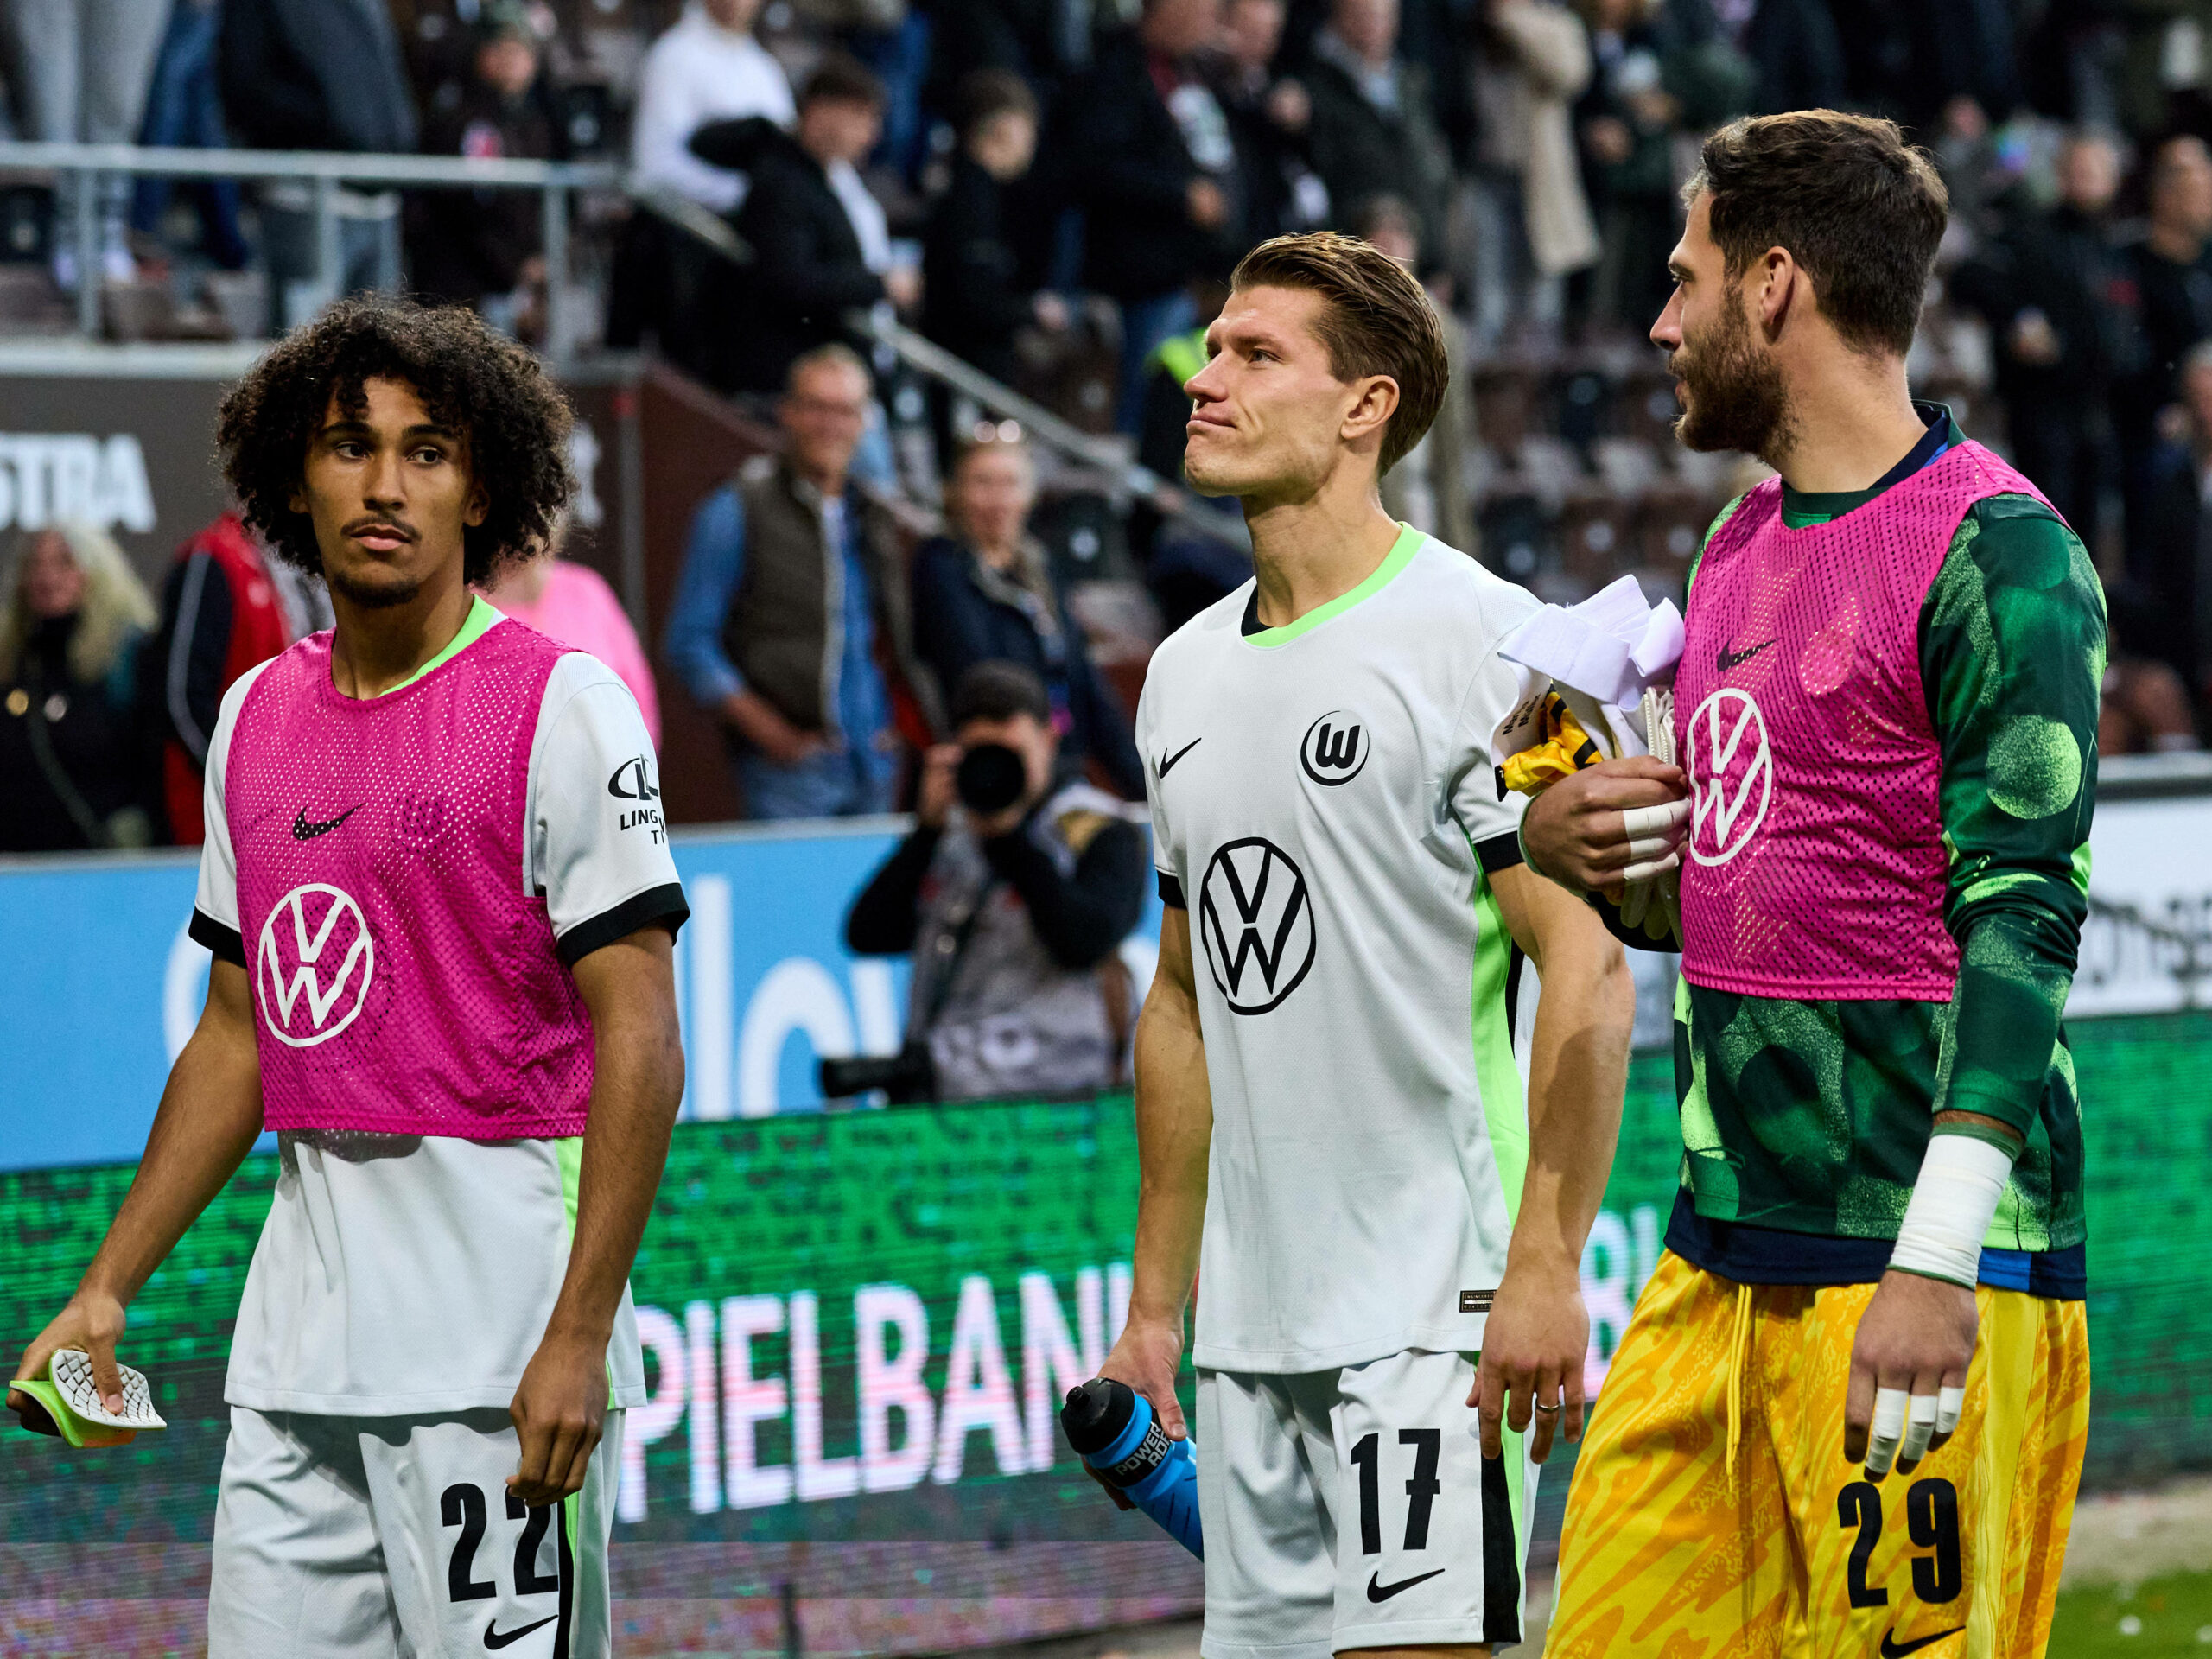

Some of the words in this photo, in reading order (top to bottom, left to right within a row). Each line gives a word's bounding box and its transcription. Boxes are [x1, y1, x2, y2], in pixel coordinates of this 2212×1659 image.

[1115, 1421, 1161, 1476] POWER
[1351, 1428, 1440, 1555] 17
[440, 1483, 559, 1602] 22
[1837, 1478, 1962, 1609] 29
